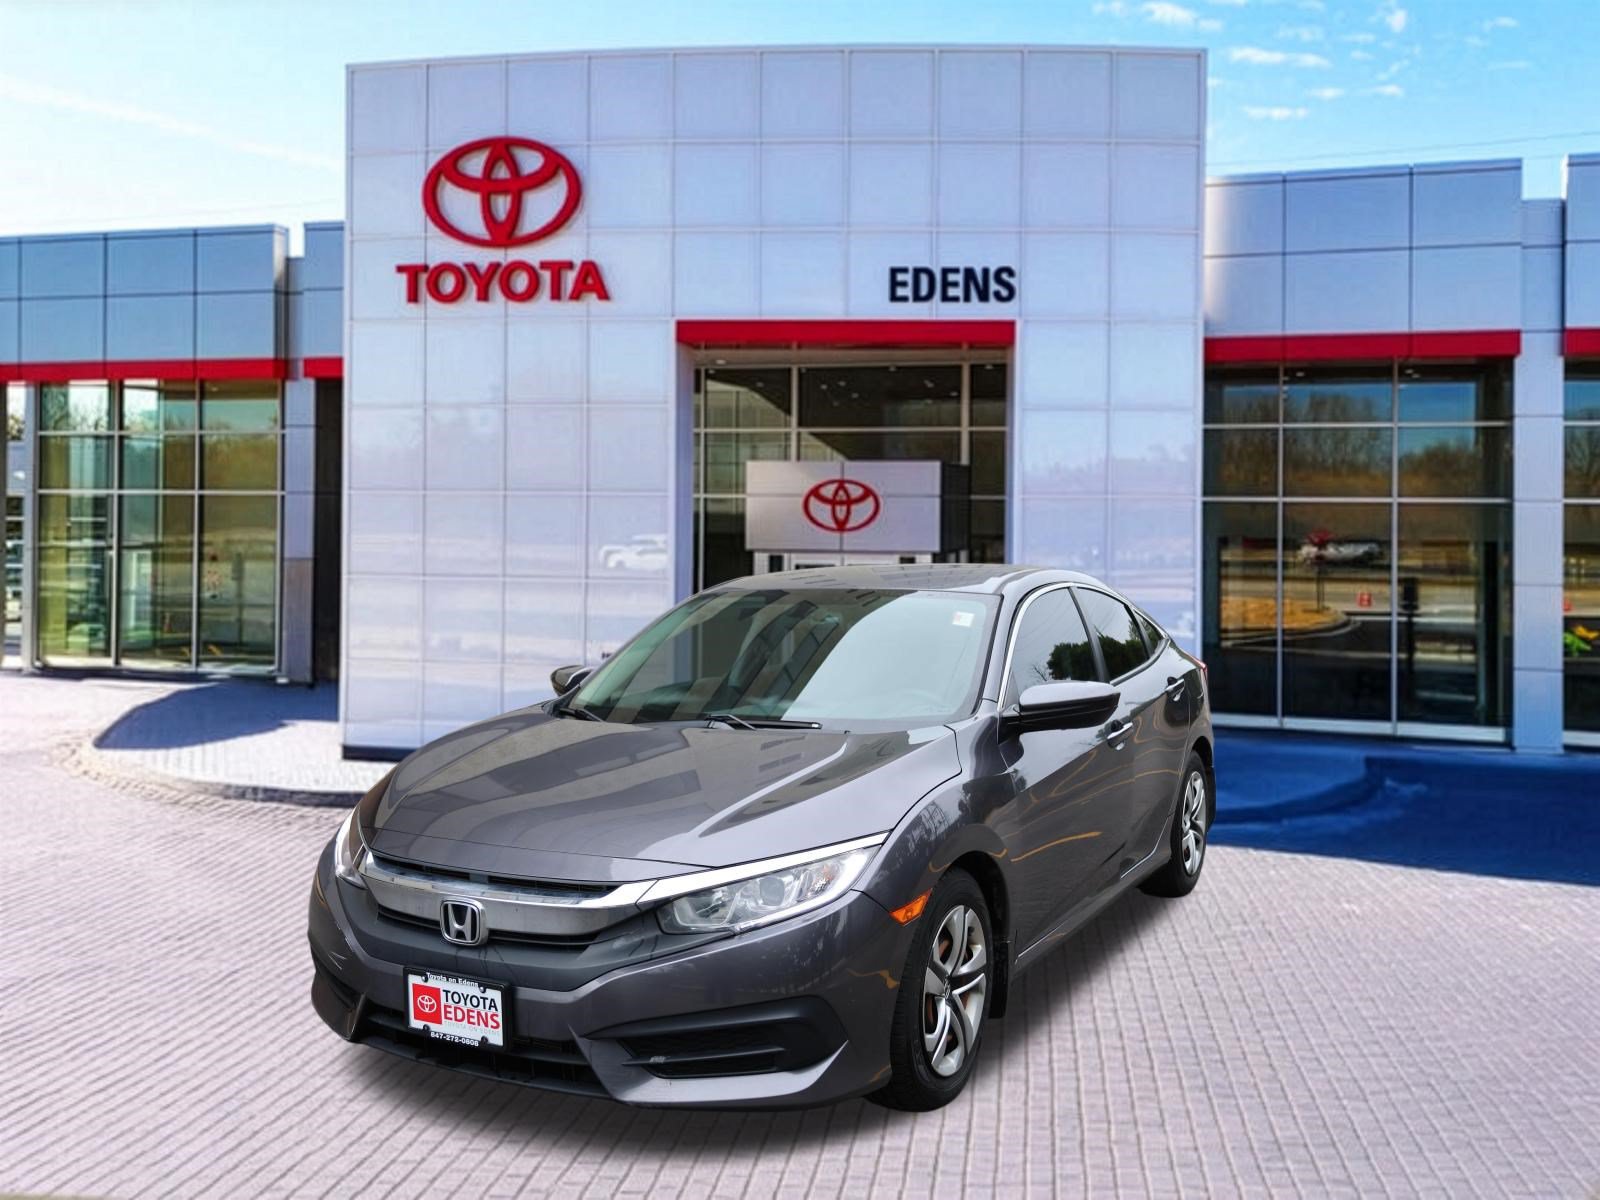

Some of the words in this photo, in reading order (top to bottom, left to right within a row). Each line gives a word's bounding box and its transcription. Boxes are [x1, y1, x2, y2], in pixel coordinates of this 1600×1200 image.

[396, 259, 610, 304] TOYOTA
[889, 265, 1017, 303] EDENS
[426, 971, 447, 982] Toyota
[458, 977, 479, 988] Edens
[442, 989, 499, 1012] TOYOTA
[443, 1004, 501, 1030] EDENS
